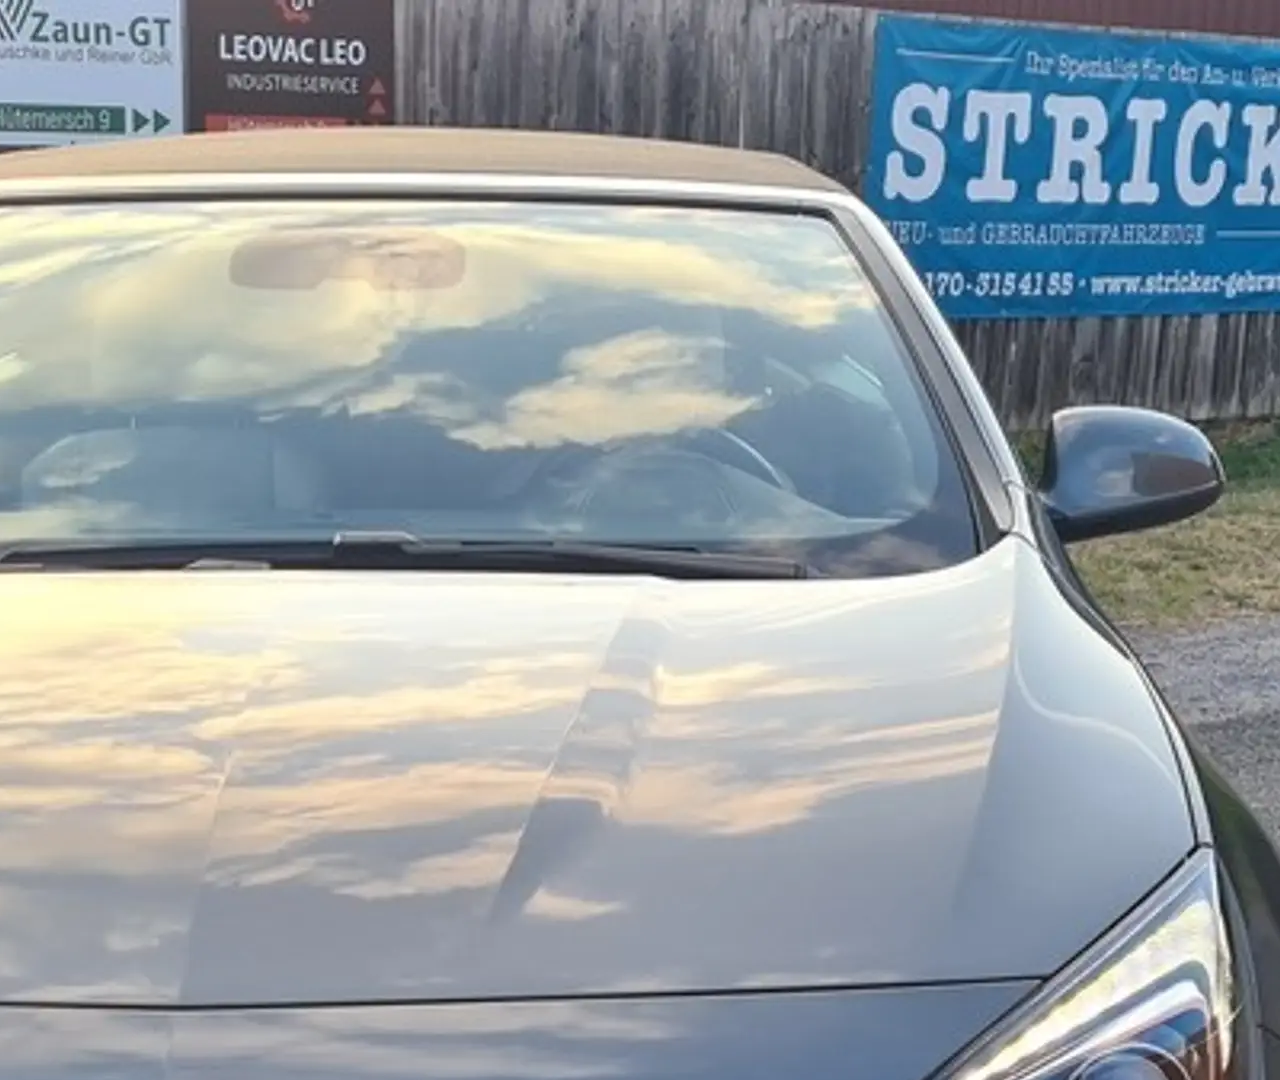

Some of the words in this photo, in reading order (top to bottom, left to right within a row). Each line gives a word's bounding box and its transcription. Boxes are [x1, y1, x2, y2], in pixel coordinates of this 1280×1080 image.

[29, 12, 172, 47] Zaun-GT
[54, 46, 84, 62] und
[219, 33, 316, 63] LEOVAC
[320, 38, 367, 66] LEO
[1025, 51, 1054, 75] Ihr
[1058, 54, 1139, 83] Spezialist
[1168, 60, 1198, 83] den
[226, 73, 360, 95] INDUSTRIESERVICE
[99, 109, 111, 131] 9
[937, 221, 977, 245] und
[981, 223, 1206, 246] GEBRAUCHTFAHRZEUGE
